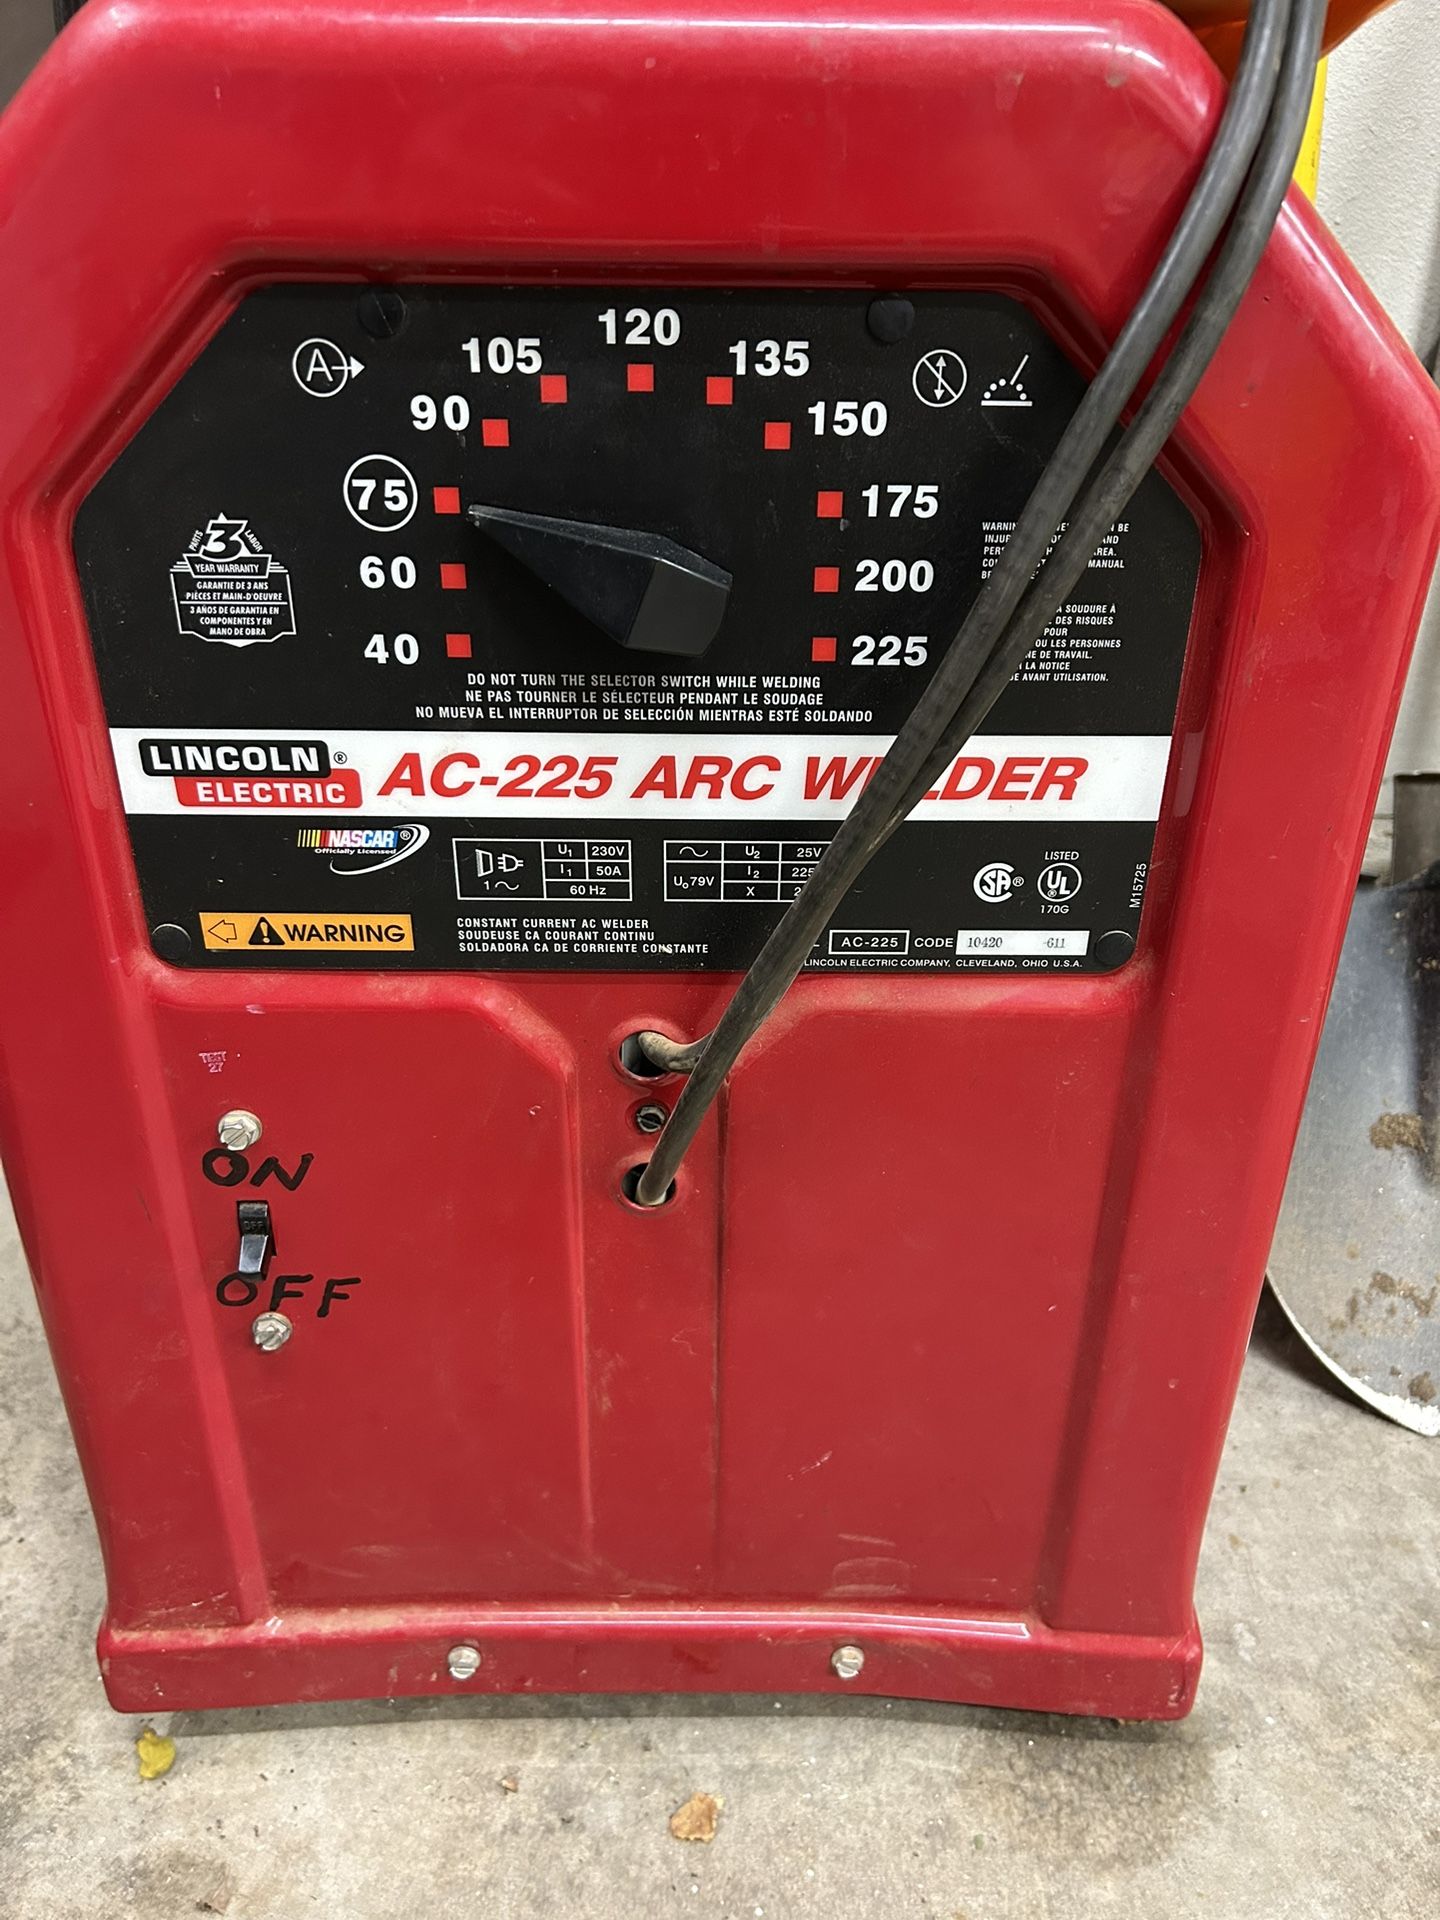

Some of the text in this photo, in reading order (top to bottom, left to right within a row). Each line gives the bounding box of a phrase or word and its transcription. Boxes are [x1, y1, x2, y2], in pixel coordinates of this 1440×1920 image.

[598, 309, 681, 346] 120
[462, 338, 542, 374] 105
[729, 341, 809, 377] 135
[410, 395, 470, 431] 90
[807, 402, 887, 437] 150
[351, 479, 407, 511] 75
[861, 485, 939, 518] 175
[982, 522, 1018, 531] WARNIN
[1117, 523, 1129, 532] BE
[189, 519, 263, 563] PARTS 3 LABOR
[984, 535, 1011, 543] INJUR
[1093, 547, 1117, 556] REA.
[195, 564, 259, 573] YEAR WARRANTY
[1088, 559, 1125, 568] MANUAL
[359, 556, 417, 590] 60
[854, 560, 934, 593] 200
[197, 582, 268, 590] GARANTIE DE 3 ANS
[213, 592, 221, 600] ET
[222, 592, 282, 601] MAIN-D'OEUVRE
[190, 604, 279, 614] 3 AÑOS DE GARANTIA EN
[1065, 605, 1107, 613] SOUDURE
[200, 617, 272, 625] COMPONENTES Y EN
[1055, 616, 1072, 625] DES
[1076, 616, 1114, 625] RISQUES
[209, 627, 266, 635] MANO DE OBRA
[1043, 627, 1068, 636] POUR
[1035, 639, 1121, 648] OU LES PERSONNES
[364, 635, 420, 665] 40
[851, 637, 928, 667] 225
[1040, 651, 1051, 659] DE
[1054, 651, 1093, 659] TRAVAIL.
[1025, 662, 1036, 670] LA
[1039, 662, 1070, 670] NOTICE
[467, 673, 821, 689] DO NOT TURN THE SELECTOR SWITCH WHILE WELDING
[1022, 673, 1050, 681] AVANT
[1053, 673, 1109, 681] UTILISATION.
[465, 689, 823, 705] NE PAS TOURNER LE SÉLECTEUR PENDANT LE SOUDAGE
[415, 706, 873, 723] NO MUEVA EL INTERRUPTOR DE SELECCIÓN MIENTRAS ESTÉ SOLDANDO
[147, 745, 321, 773] LINCOLN
[377, 753, 1089, 801] AC-225 ARC WDER
[197, 782, 346, 804] ELECTRIC
[328, 829, 395, 848] NASCAR
[591, 845, 625, 857] 230V
[797, 847, 822, 859] 25V
[1044, 851, 1080, 861] LISTED
[596, 865, 622, 877] 50A
[569, 884, 607, 896] 60 Hz
[746, 886, 756, 896] X
[1129, 863, 1147, 909] M15725
[1040, 905, 1070, 914] 170G
[456, 918, 649, 929] CONSTANT CURRENT AC WELDER
[283, 923, 405, 944] WARNING
[458, 930, 655, 941] SOUDEUSE CA COURANT CONTINU
[459, 942, 709, 954] SOLDADORA CA DE CORRIENTE CONSTANTE
[841, 937, 899, 948] AC-225
[914, 937, 954, 948] CODE
[967, 937, 1003, 949] 10420
[804, 958, 1083, 968] LINCOLN ELECTRIC COMPANY, CLEVELAND, OHIO U.S.A.
[202, 1148, 314, 1191] ON
[216, 1272, 361, 1318] OFF
